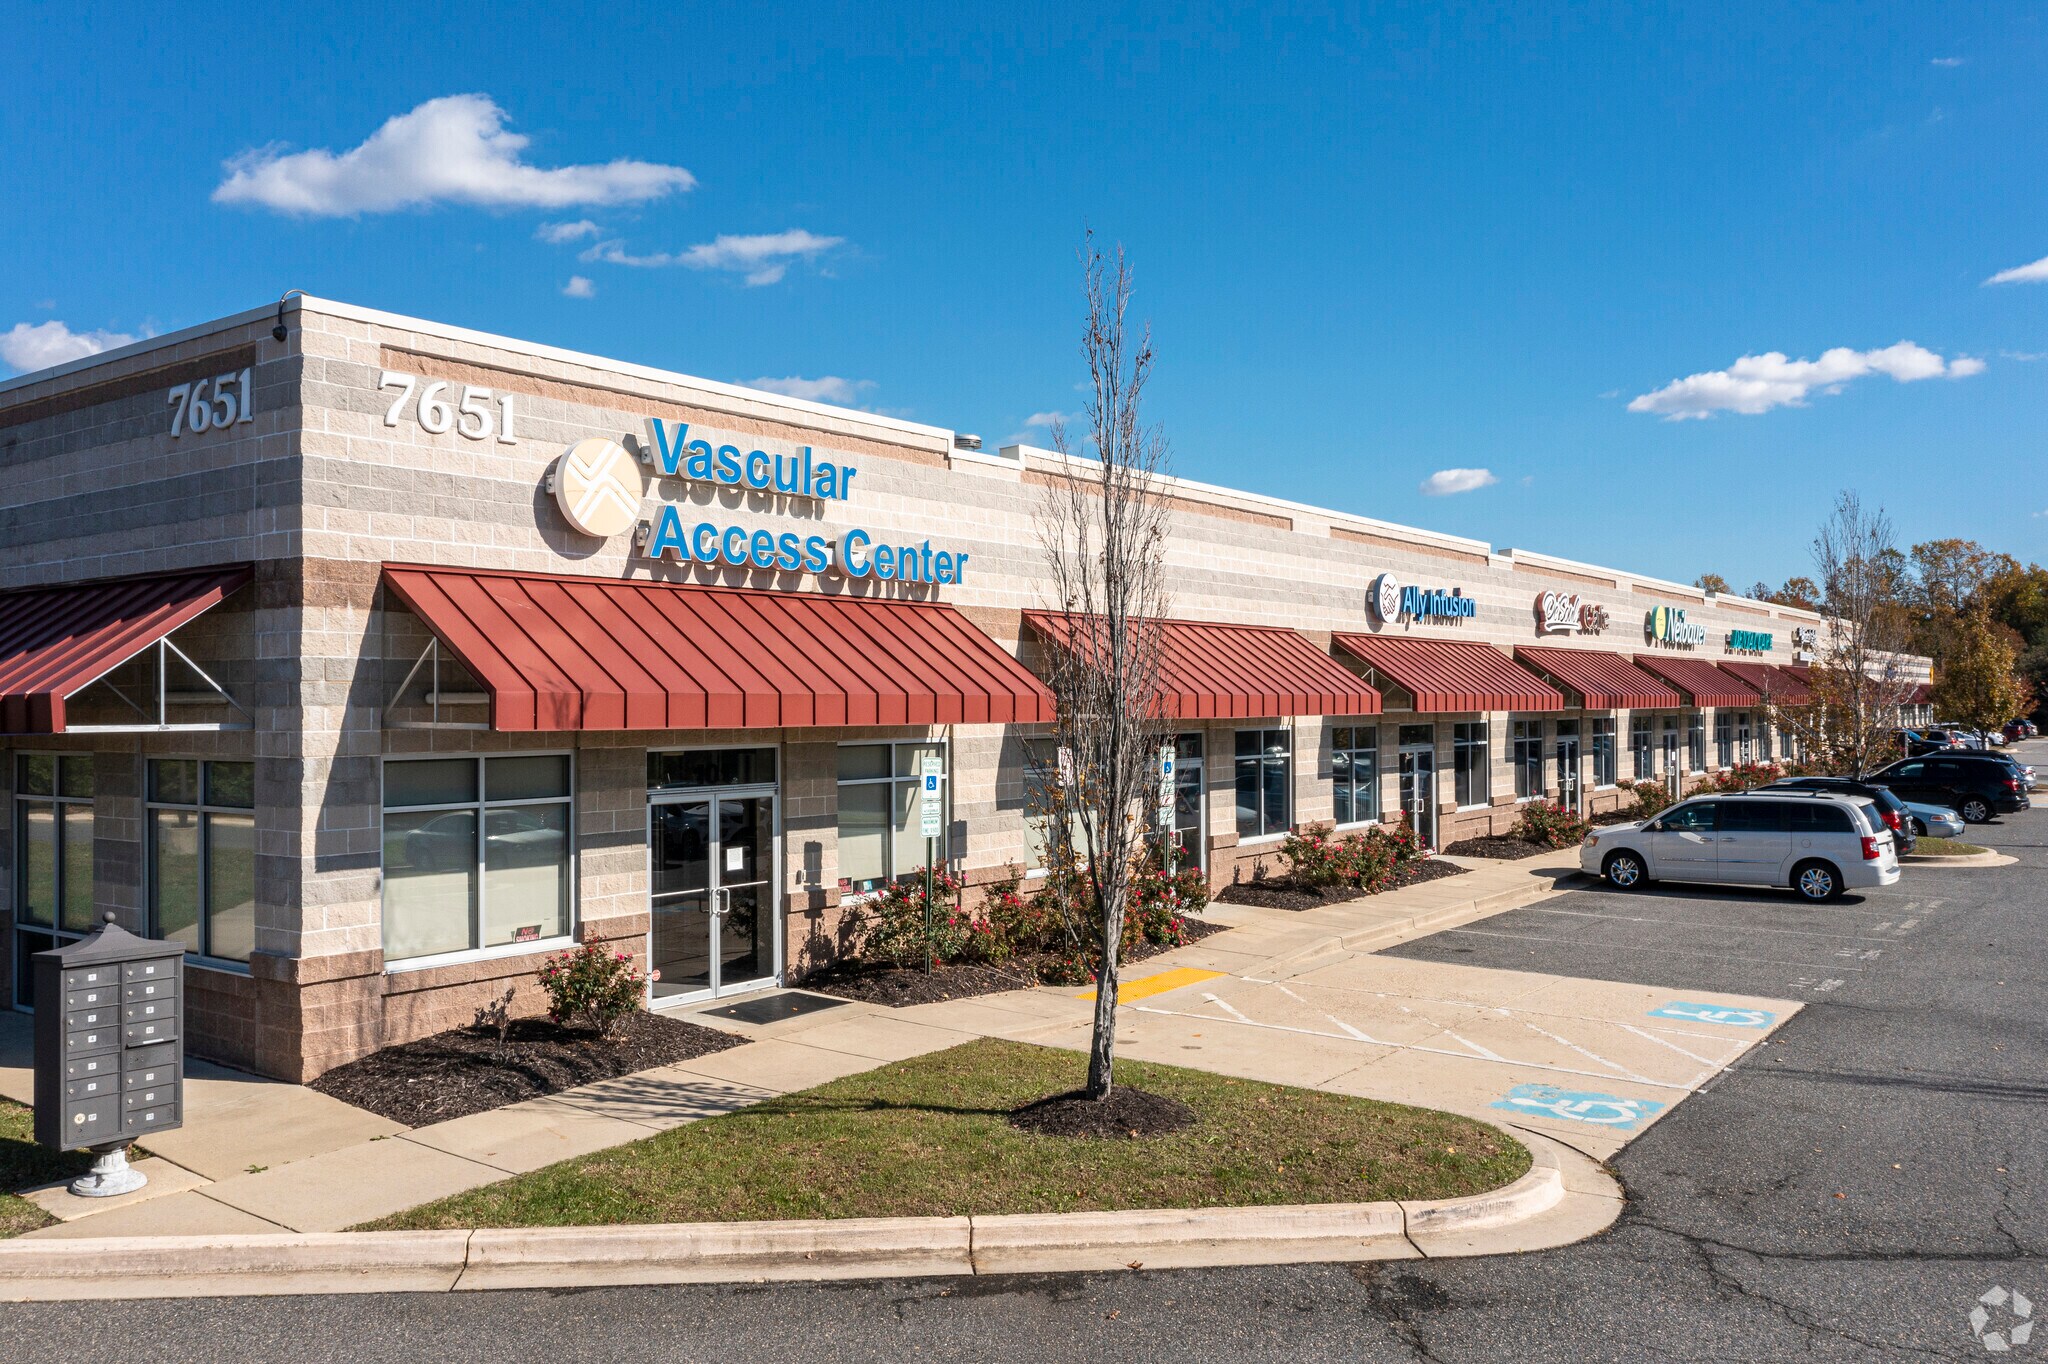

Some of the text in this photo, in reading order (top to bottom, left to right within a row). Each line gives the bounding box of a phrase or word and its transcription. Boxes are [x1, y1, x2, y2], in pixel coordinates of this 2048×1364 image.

[167, 367, 254, 438] 7651
[378, 370, 518, 446] 7651
[647, 417, 858, 501] Vascular
[648, 504, 970, 586] Access Center
[1402, 586, 1477, 622] Ally Infusion
[1666, 607, 1708, 645] Neibauer
[521, 927, 535, 936] NO
